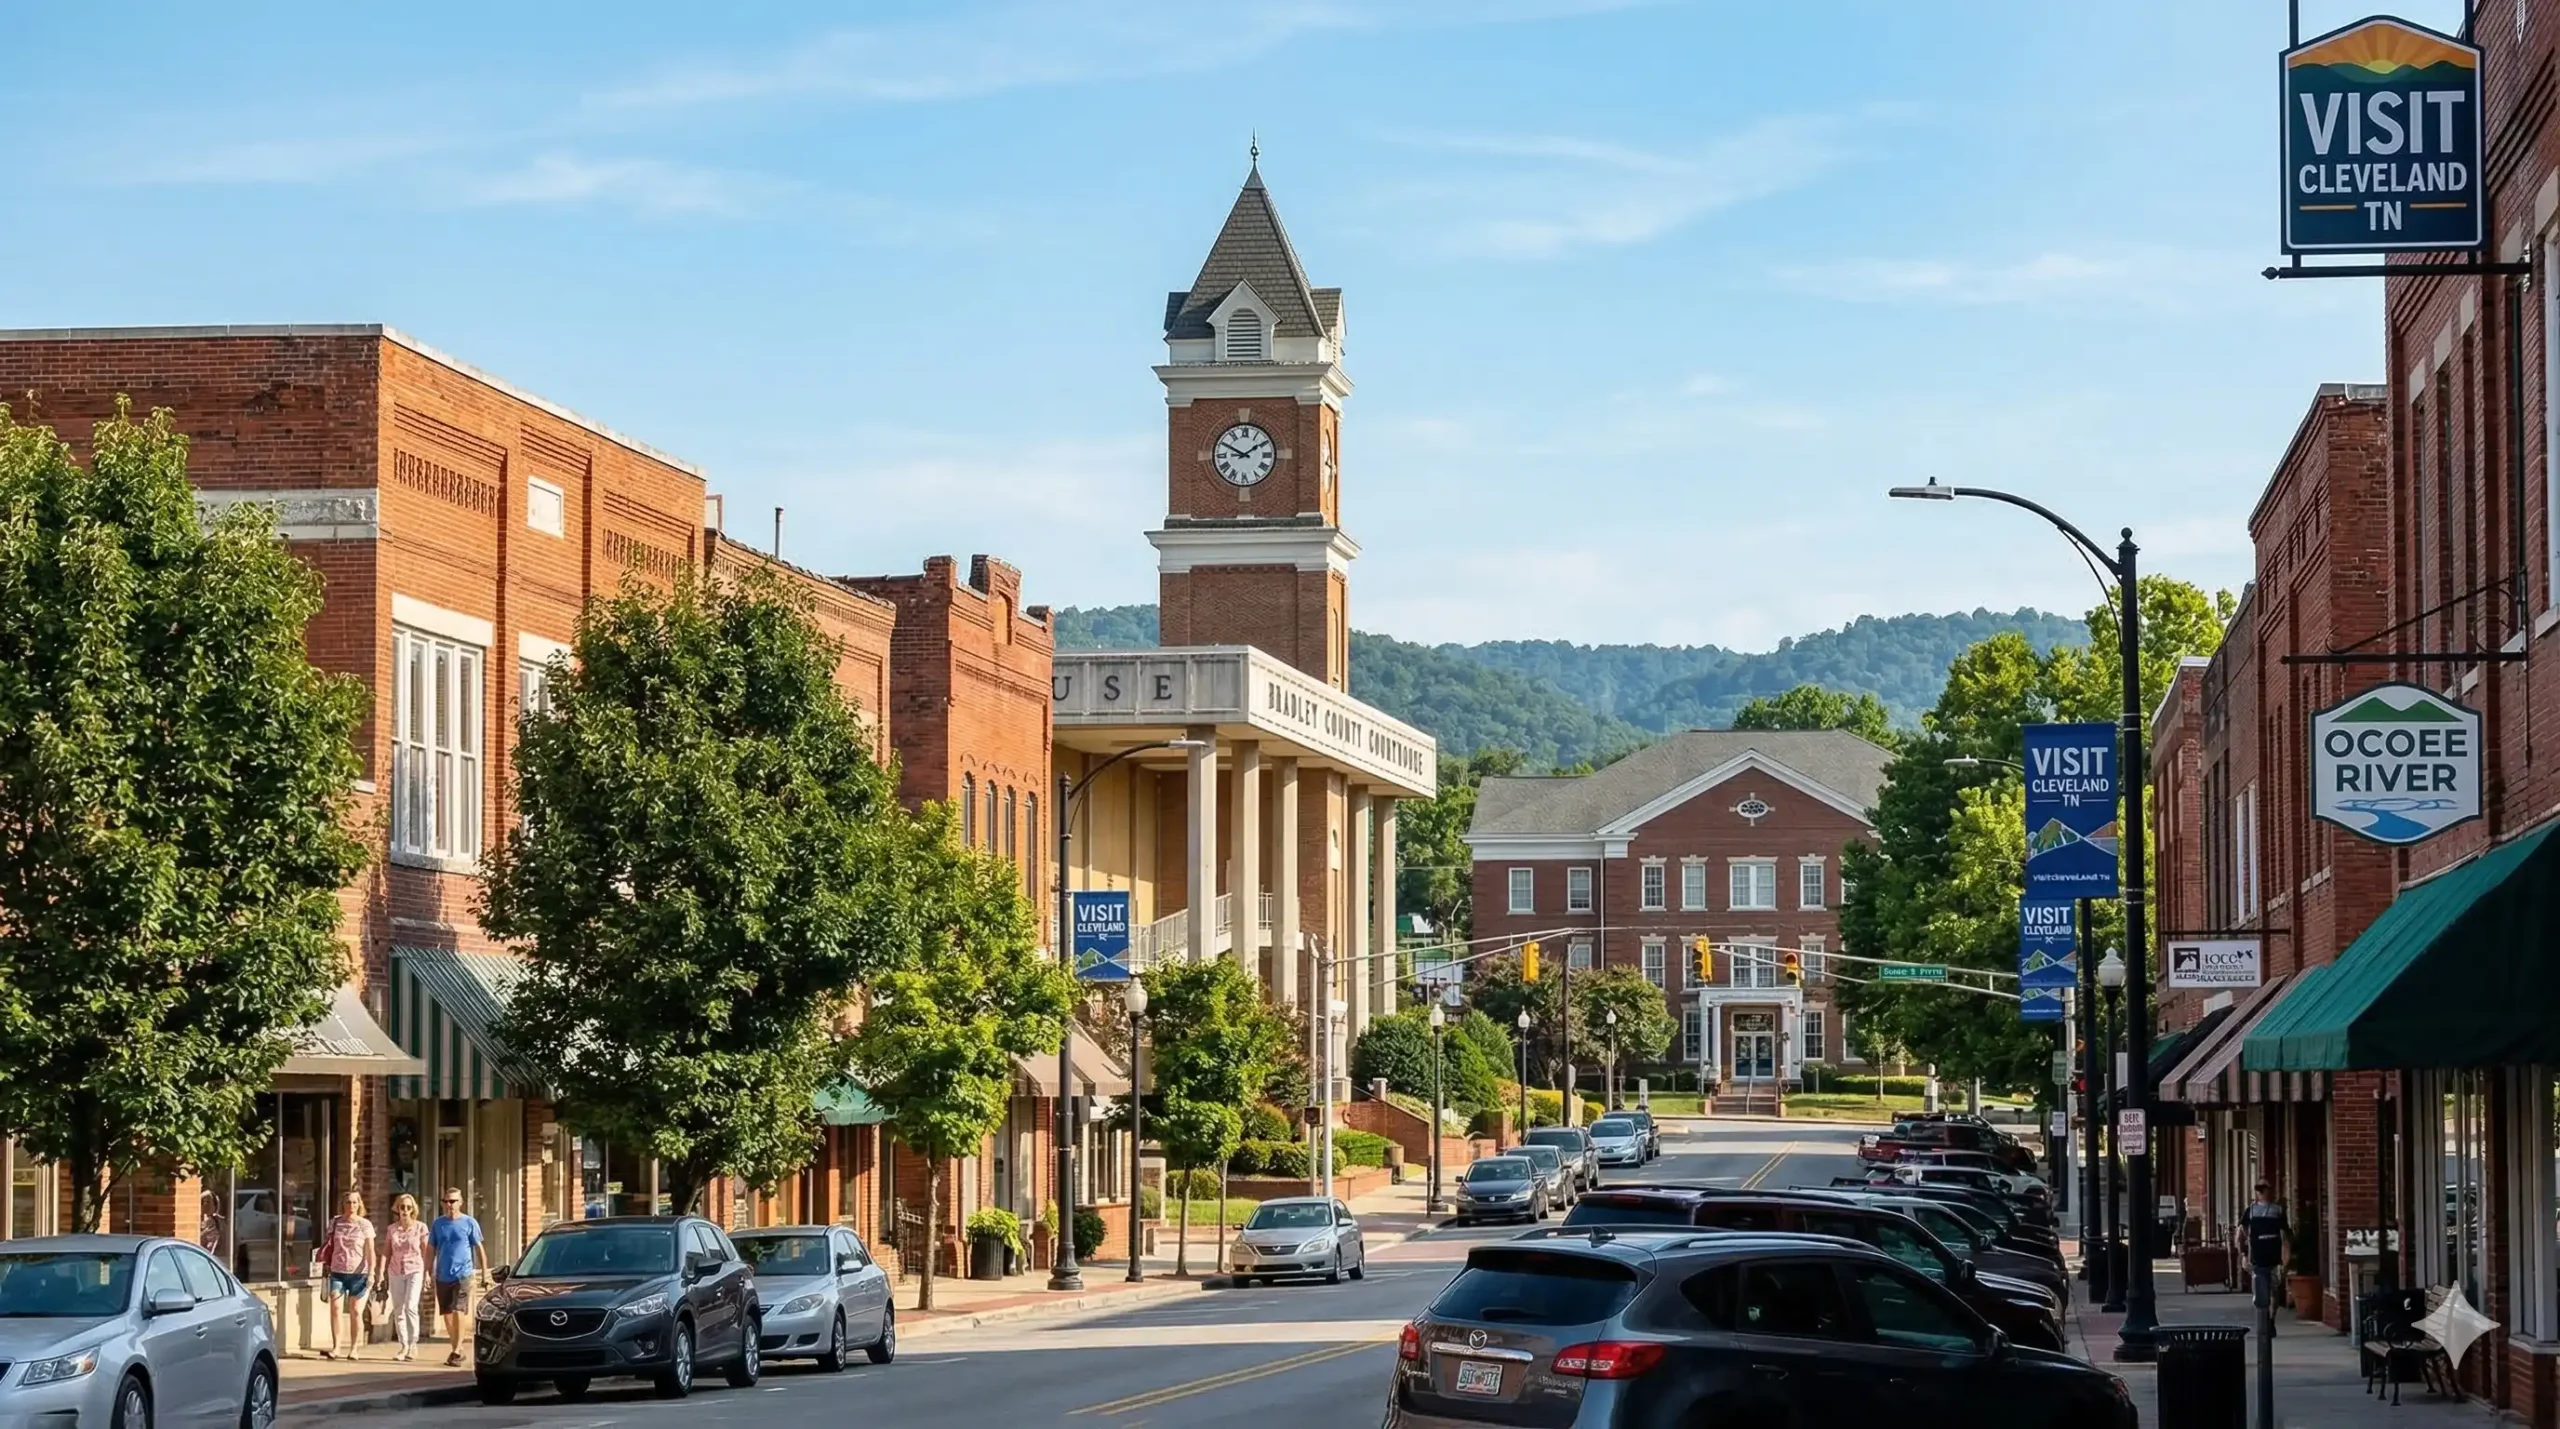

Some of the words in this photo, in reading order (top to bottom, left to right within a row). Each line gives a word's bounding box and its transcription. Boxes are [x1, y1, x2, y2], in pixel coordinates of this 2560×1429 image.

[2299, 90, 2466, 155] VISIT
[2298, 162, 2468, 194] CLEVELAND
[2363, 201, 2403, 231] TN
[1052, 675, 1173, 701] USE
[1268, 681, 1318, 729] BRADLEY
[1324, 708, 1362, 748] COUNTY
[2324, 729, 2468, 758] OCOEE
[2031, 747, 2109, 776] VISIT
[2031, 777, 2110, 794] CLEVELAND
[2336, 763, 2458, 792] RIVER
[2063, 794, 2081, 807] TN
[1078, 904, 1124, 922] VISIT
[2024, 907, 2071, 924] VISIT
